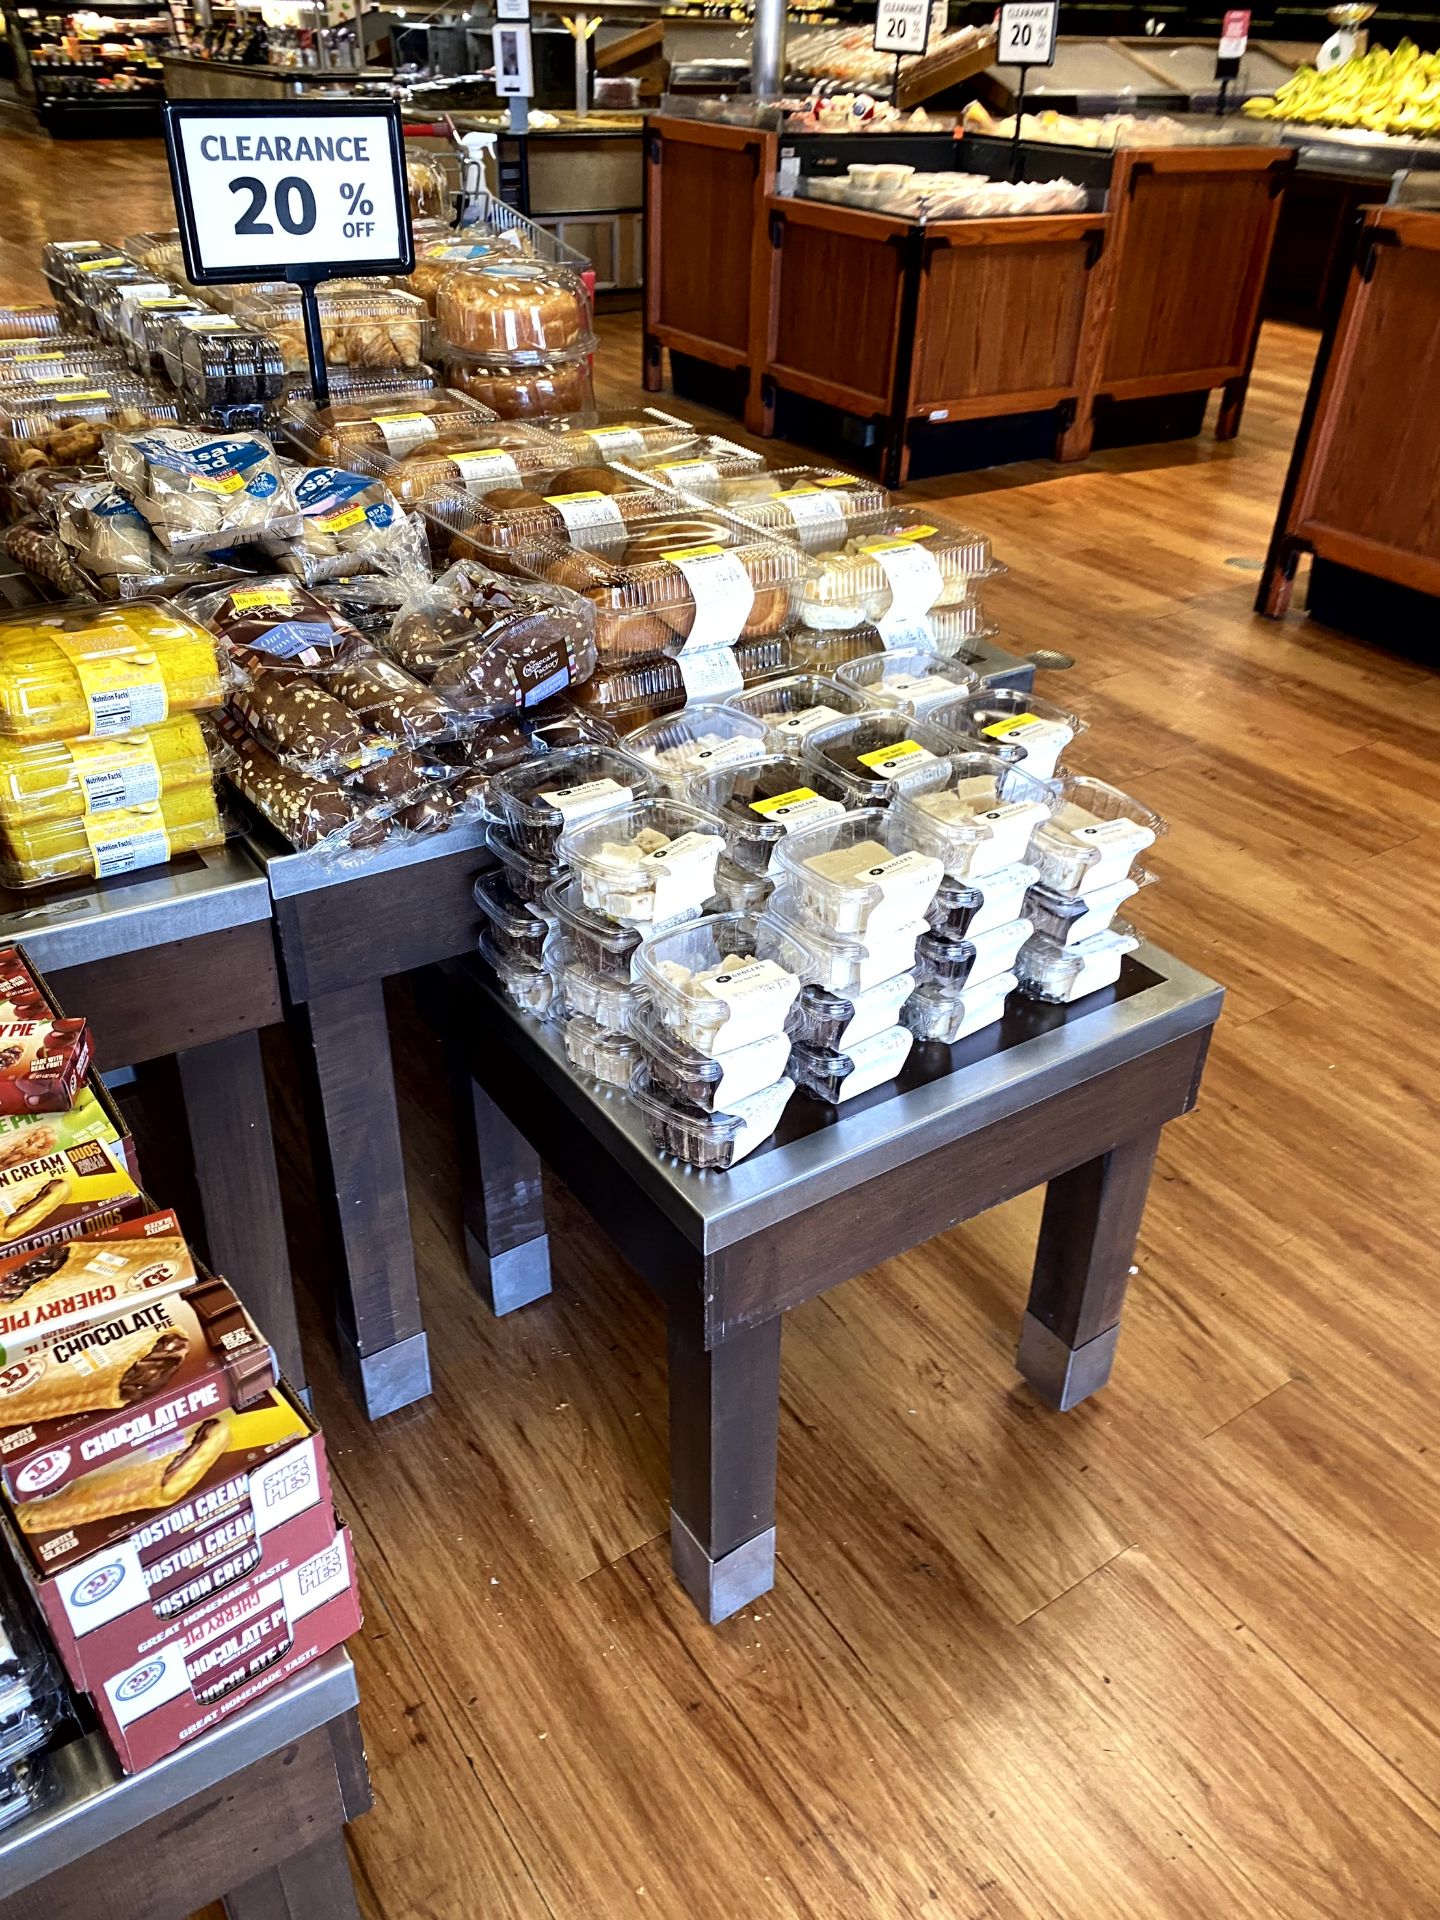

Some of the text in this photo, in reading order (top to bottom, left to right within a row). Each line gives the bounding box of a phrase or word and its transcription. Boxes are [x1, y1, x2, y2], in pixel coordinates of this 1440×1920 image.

[887, 18, 906, 38] 20
[1010, 24, 1032, 46] 20
[200, 135, 370, 162] CLEARANCE
[228, 176, 374, 236] 20 %
[342, 222, 375, 238] OFF
[216, 471, 233, 481] SALE
[251, 484, 275, 493] PLASTIC
[340, 505, 355, 515] SALE
[367, 505, 387, 518] BPA
[261, 633, 280, 648] Our
[267, 635, 296, 653] rown
[523, 651, 558, 678] Cheesecake
[534, 658, 559, 680] Factory
[92, 692, 129, 703] Nutrition Facts
[86, 773, 122, 785] Nutrition Facts
[97, 840, 131, 853] Nutrition Facts
[732, 964, 766, 978] GROCERS
[9, 1023, 36, 1037] PIE
[31, 1054, 63, 1066] MADE WITH
[31, 1060, 63, 1072] REAL FRUIT
[10, 1113, 44, 1129] PIE
[67, 1142, 102, 1163] DUOS
[10, 1154, 65, 1182] CREAM
[50, 1166, 69, 1178] PIE
[0, 1207, 123, 1260] TON CREAM DUOS
[0, 1285, 117, 1335] CHERRY PIE
[53, 1302, 169, 1363] CHOCOLATE
[154, 1318, 175, 1332] PIE
[80, 1397, 189, 1461] CHOCOLATE
[187, 1383, 220, 1412] PIE
[1, 1432, 37, 1454] GLAZED
[263, 1454, 309, 1490] SNACK
[264, 1470, 311, 1508] PIES
[130, 1504, 196, 1553] BOSTON
[39, 1530, 74, 1554] LIGHTLY
[42, 1537, 79, 1562] GLAZED
[142, 1540, 204, 1588] BOSTON
[298, 1546, 340, 1582] SNACK
[299, 1559, 342, 1596] PIES
[138, 1558, 290, 1653] GREAT HOMEMADE TASTE
[179, 1592, 260, 1650] CHERRY PIE
[188, 1617, 273, 1680] HOCOLATE
[179, 1645, 319, 1740] GREAT HOMEMADE TASTE
